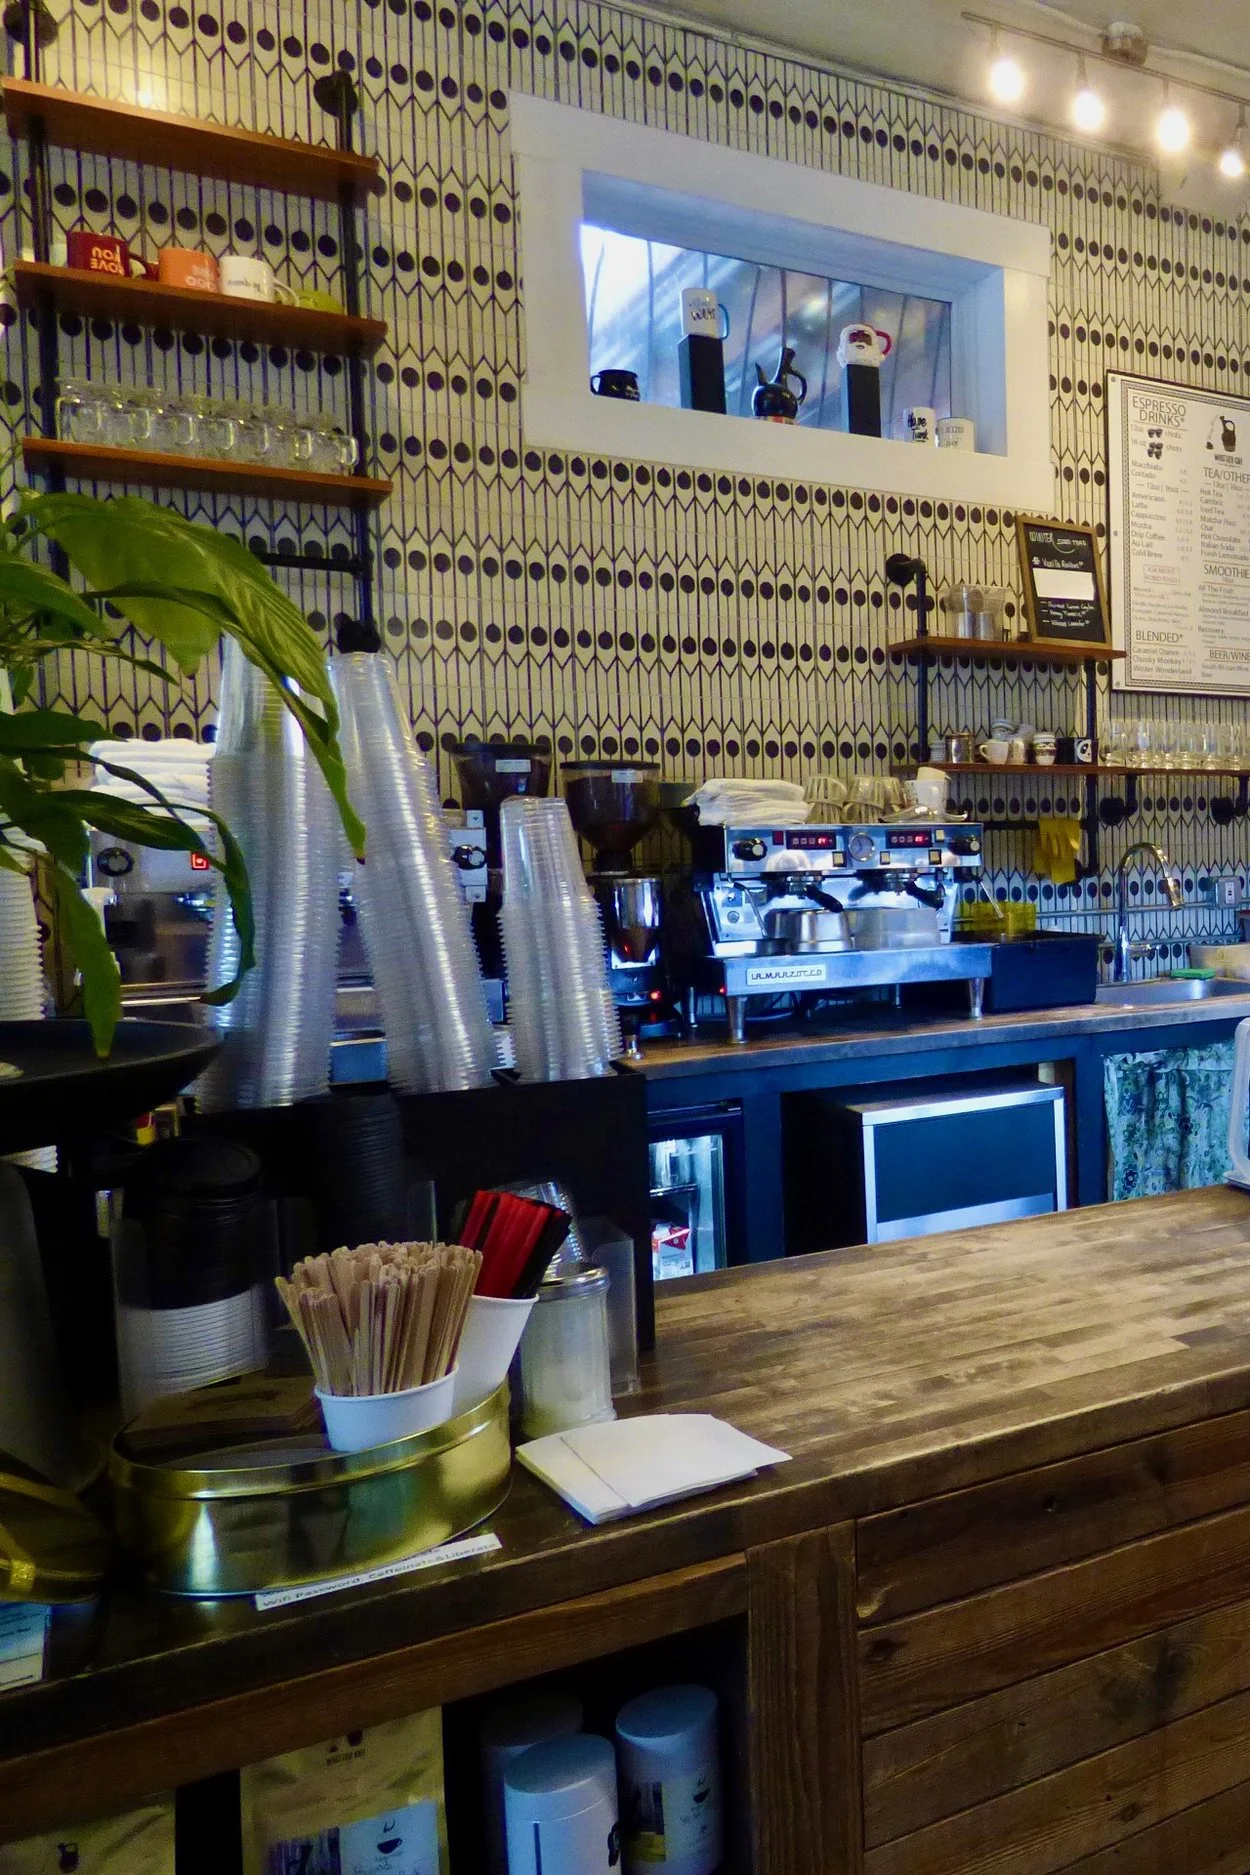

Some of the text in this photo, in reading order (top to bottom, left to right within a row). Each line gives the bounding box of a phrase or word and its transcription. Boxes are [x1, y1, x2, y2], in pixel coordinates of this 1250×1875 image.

[1132, 396, 1187, 416] ESPRESSO
[1131, 492, 1165, 502] Americano
[1131, 510, 1166, 520] Cappuccino
[1198, 606, 1221, 614] Almond
[1198, 625, 1224, 634] Recovery
[1132, 646, 1158, 654] Caramel
[1155, 666, 1193, 675] Wonderland
